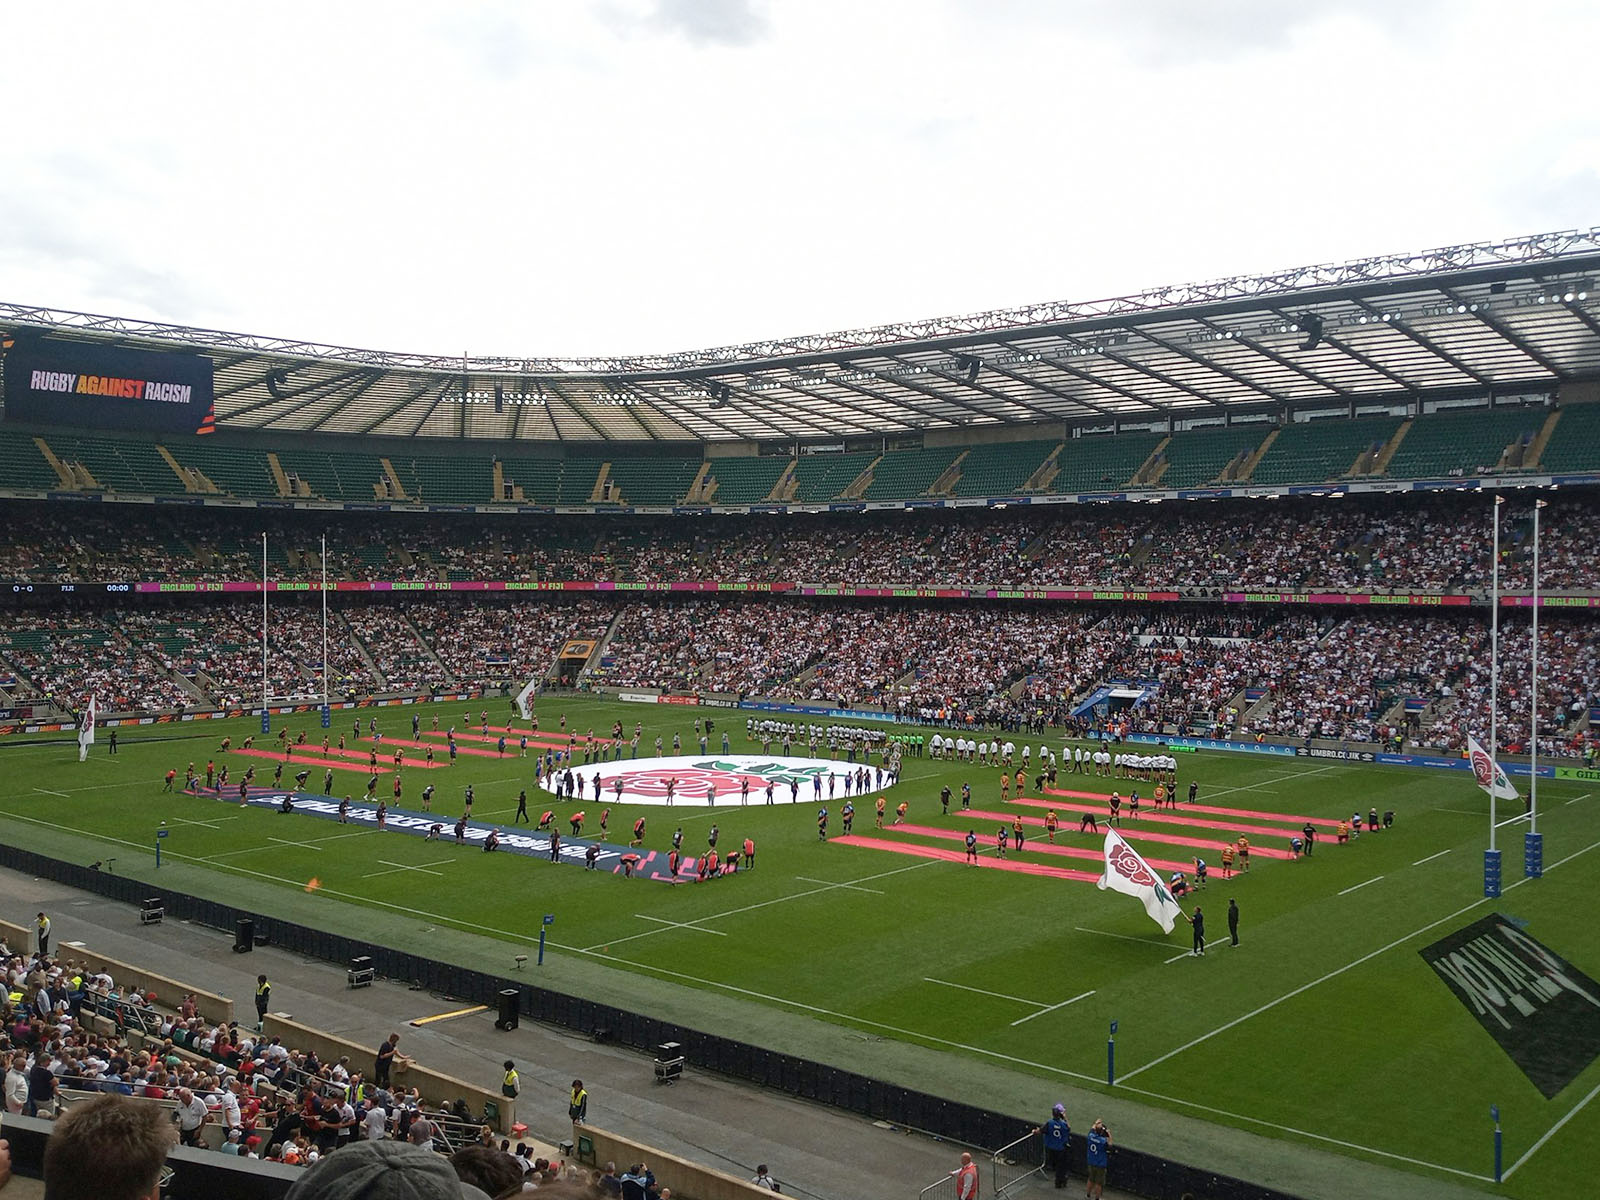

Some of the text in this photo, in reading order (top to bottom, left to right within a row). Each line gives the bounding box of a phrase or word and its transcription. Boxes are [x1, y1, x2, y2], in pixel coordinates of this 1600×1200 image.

[30, 370, 192, 404] RUGBY AGAINST RACISM
[1433, 933, 1564, 1030] TikTok
